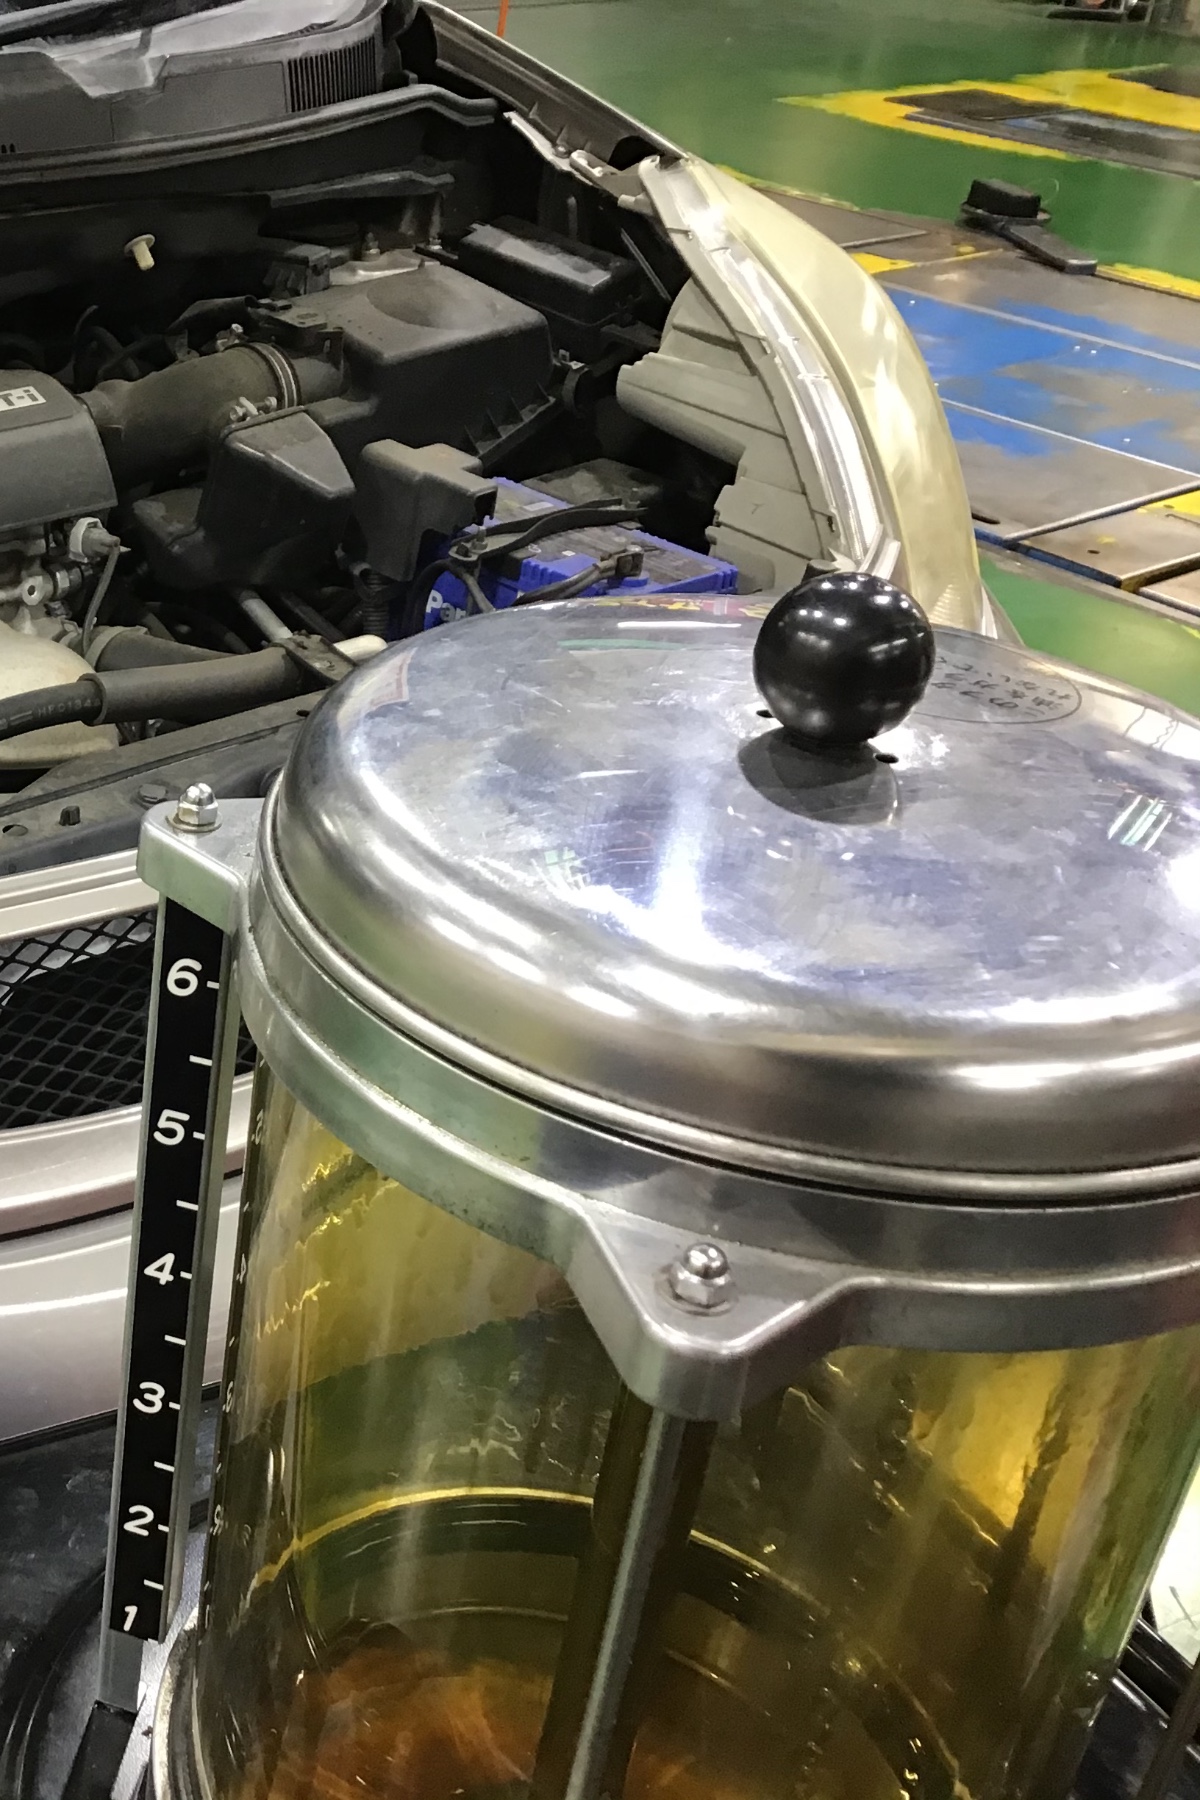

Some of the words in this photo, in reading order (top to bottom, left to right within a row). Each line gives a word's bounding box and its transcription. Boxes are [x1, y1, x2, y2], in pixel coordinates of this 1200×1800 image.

[166, 958, 202, 996] 6
[153, 1109, 190, 1145] 5
[143, 1252, 175, 1285] 4
[133, 1381, 165, 1414] 3
[123, 1504, 154, 1536] 2
[123, 1605, 137, 1631] 1
